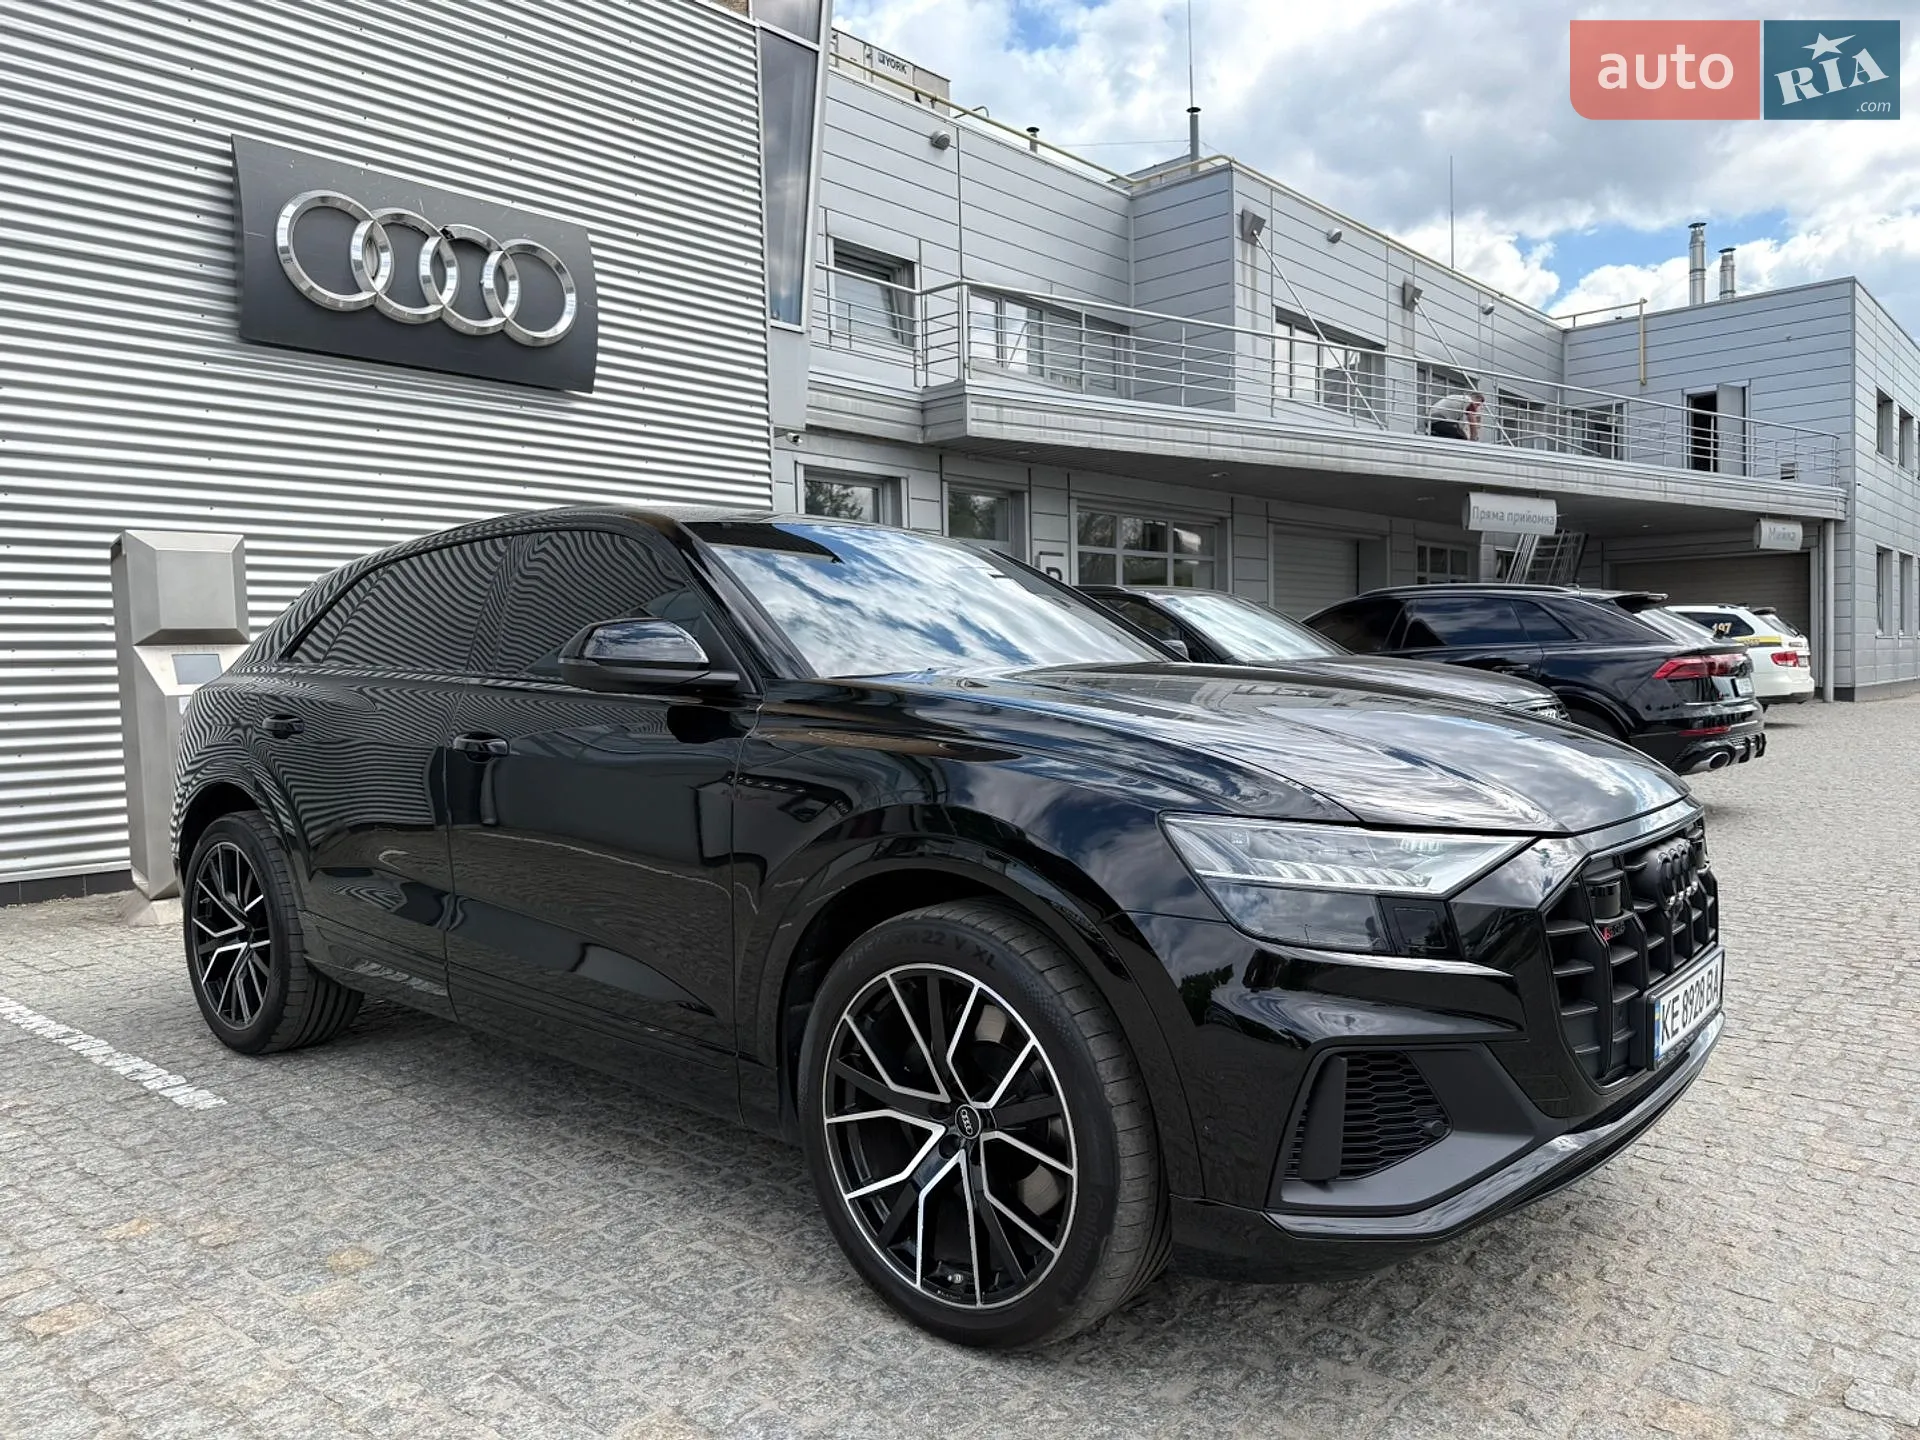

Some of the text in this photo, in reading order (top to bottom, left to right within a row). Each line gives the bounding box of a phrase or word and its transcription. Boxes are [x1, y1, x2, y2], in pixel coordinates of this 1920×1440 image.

[885, 56, 907, 75] YORK
[1472, 505, 1555, 526] Пряма прийомка
[1661, 994, 1680, 1046] KE
